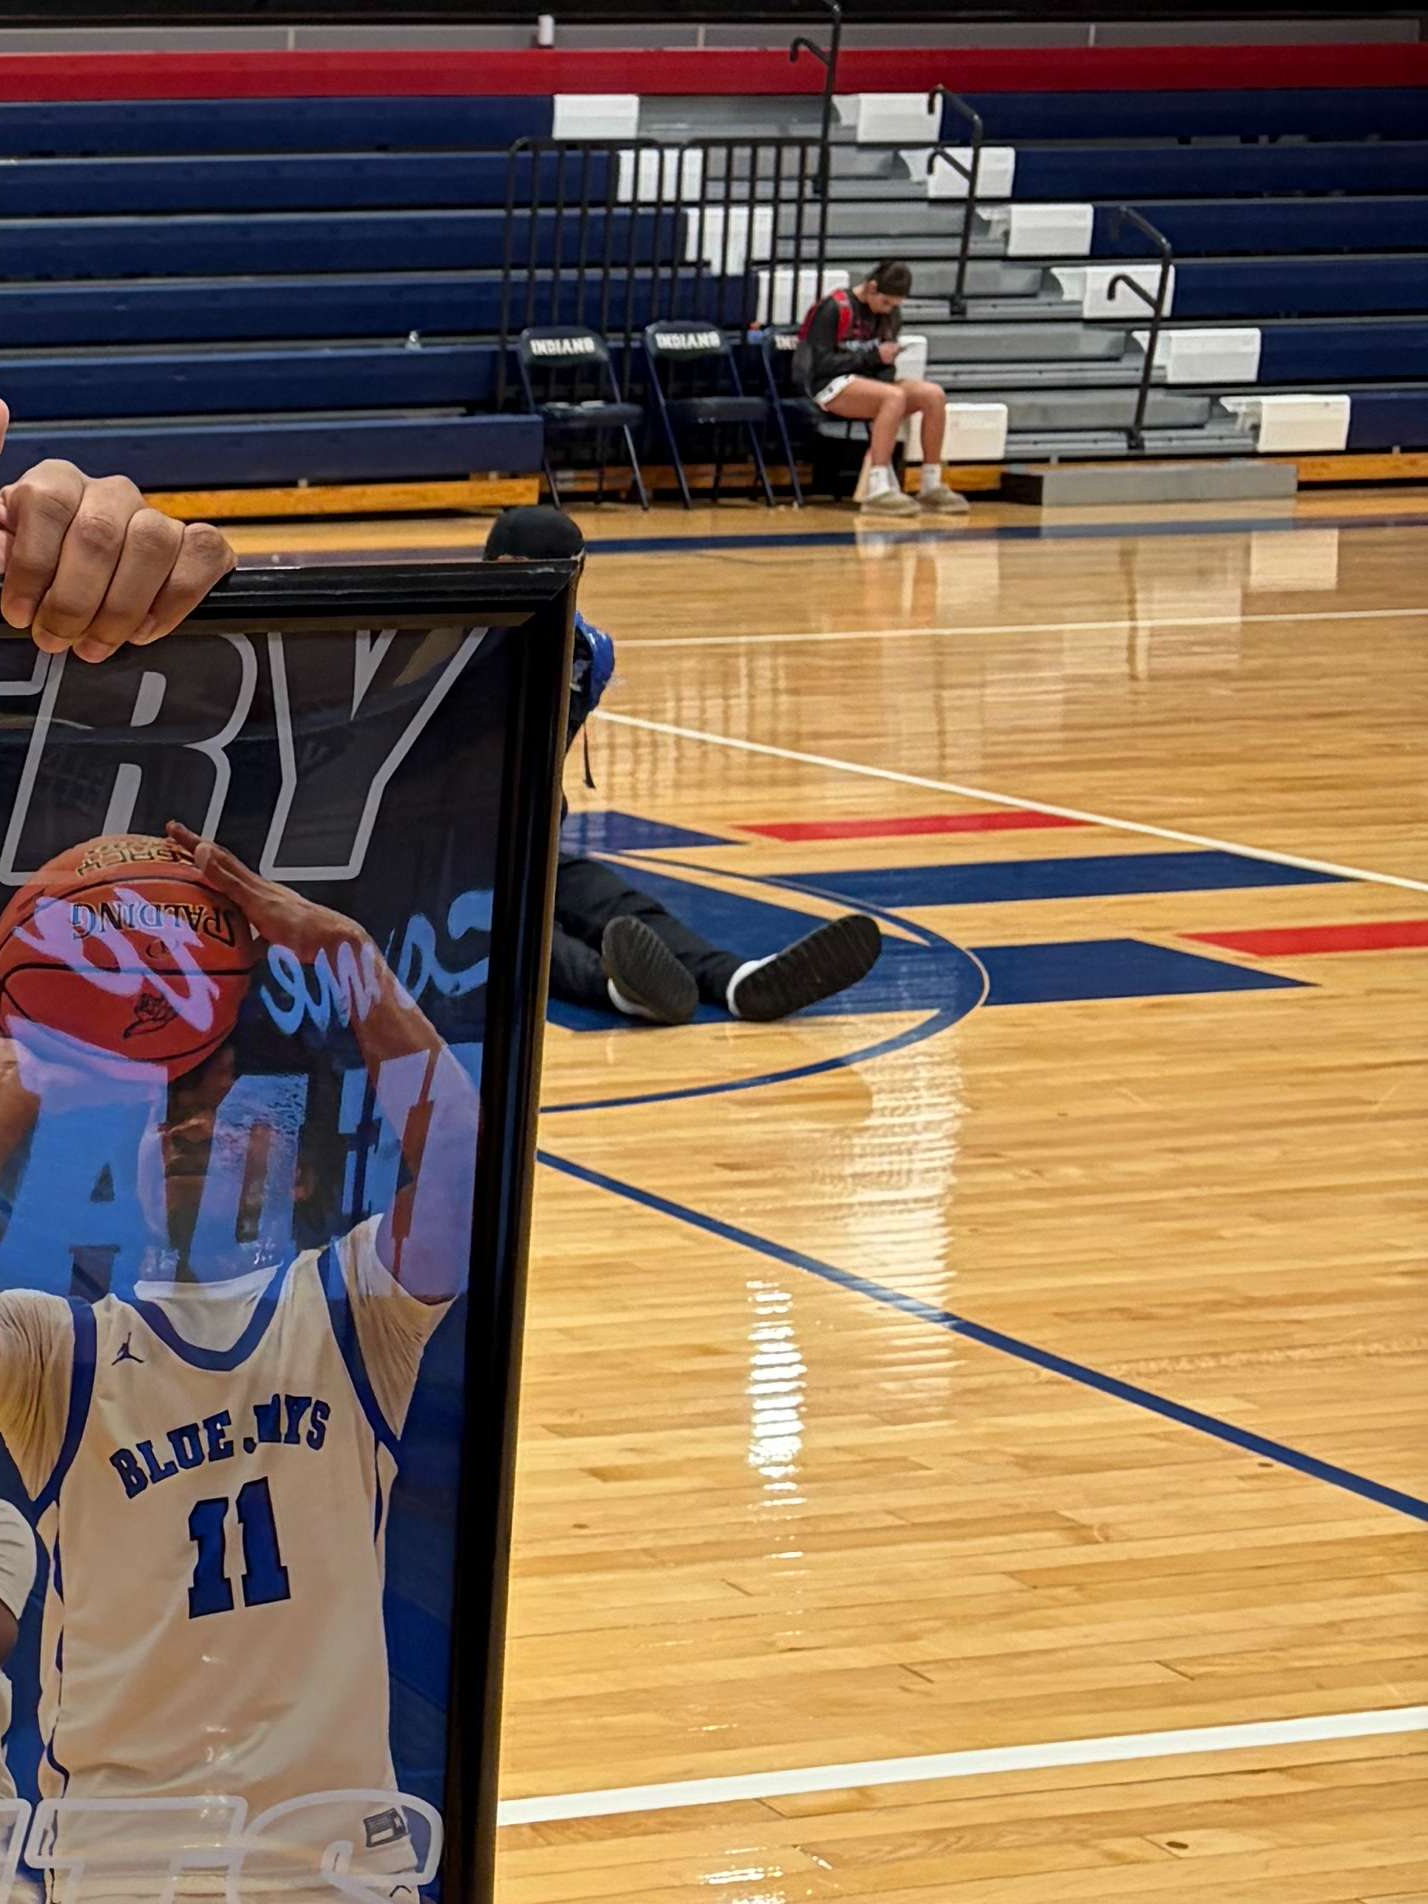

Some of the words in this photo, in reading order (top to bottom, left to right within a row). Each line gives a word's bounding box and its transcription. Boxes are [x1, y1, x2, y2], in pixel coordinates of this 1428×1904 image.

[530, 335, 595, 357] INDIANS
[654, 330, 722, 351] INDIANS
[109, 1408, 234, 1500] BLUE
[187, 1475, 292, 1620] 11
